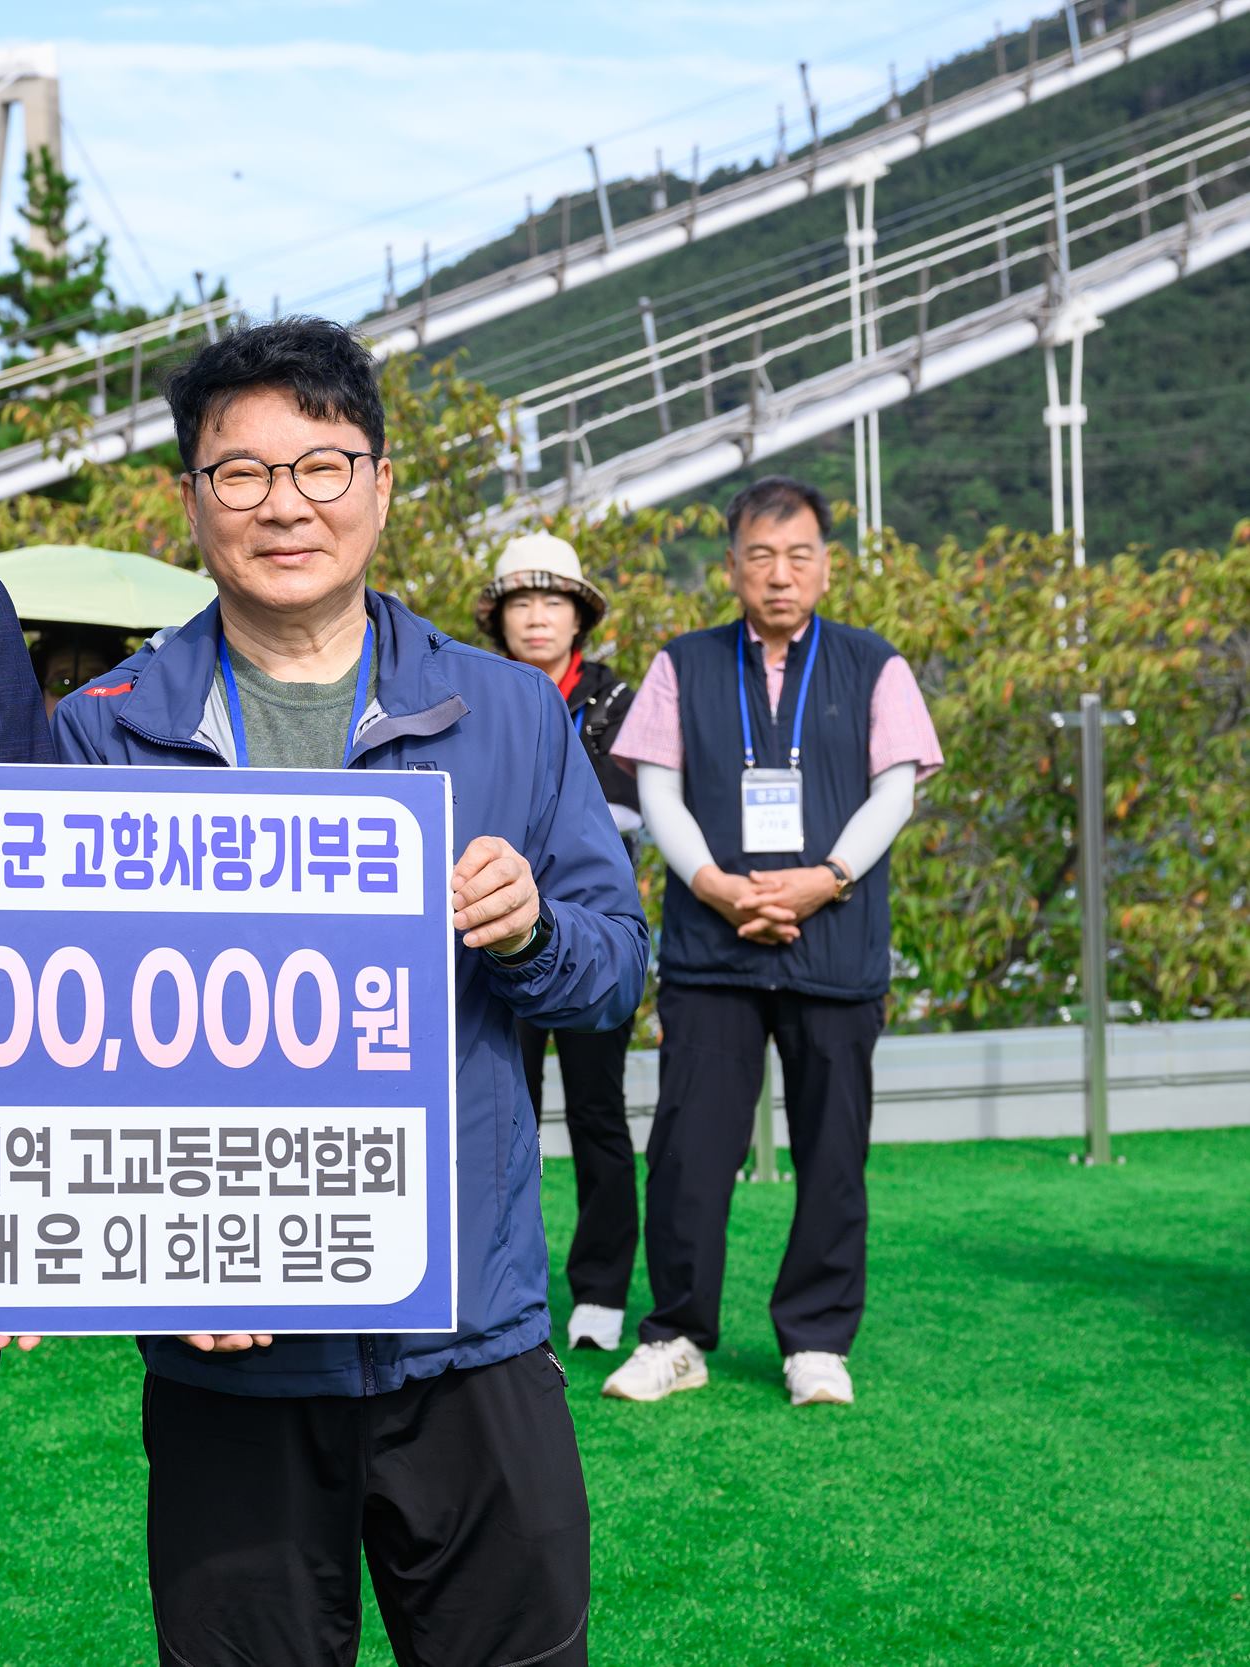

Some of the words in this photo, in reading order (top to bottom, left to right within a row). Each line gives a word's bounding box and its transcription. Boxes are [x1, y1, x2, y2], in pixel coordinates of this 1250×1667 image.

[61, 811, 400, 894] 고향사랑기부금
[67, 1125, 406, 1198] 고교동문연합회
[101, 1213, 147, 1285] 외
[164, 1212, 262, 1285] 회원
[278, 1213, 376, 1285] 일동
